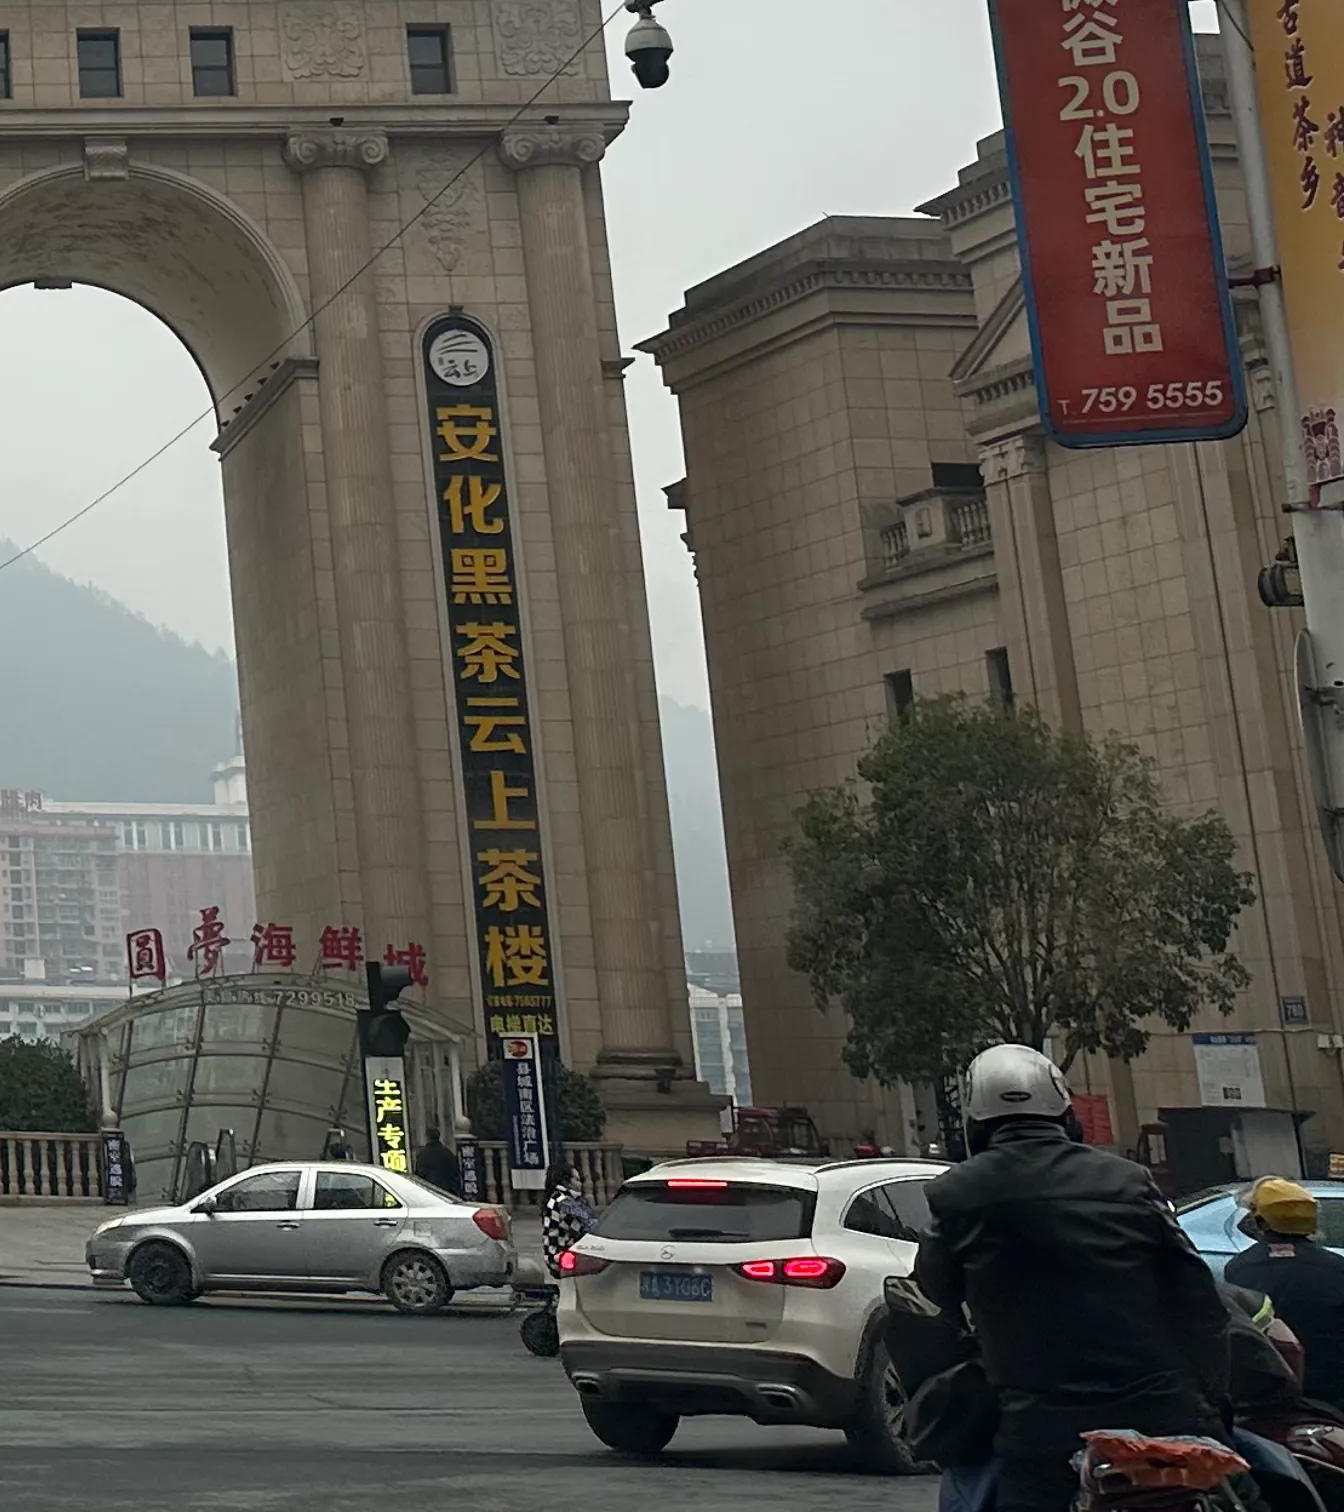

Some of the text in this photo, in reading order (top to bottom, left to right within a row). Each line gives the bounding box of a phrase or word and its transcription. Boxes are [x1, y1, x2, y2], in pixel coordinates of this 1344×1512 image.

[1080, 387, 1137, 414] 759
[1145, 381, 1223, 410] 5555
[436, 404, 550, 987] 安化黑茶云上茶楼
[273, 990, 355, 1007] 7299518
[490, 1014, 554, 1034] 电梯直达
[374, 1079, 408, 1172] 生产专项
